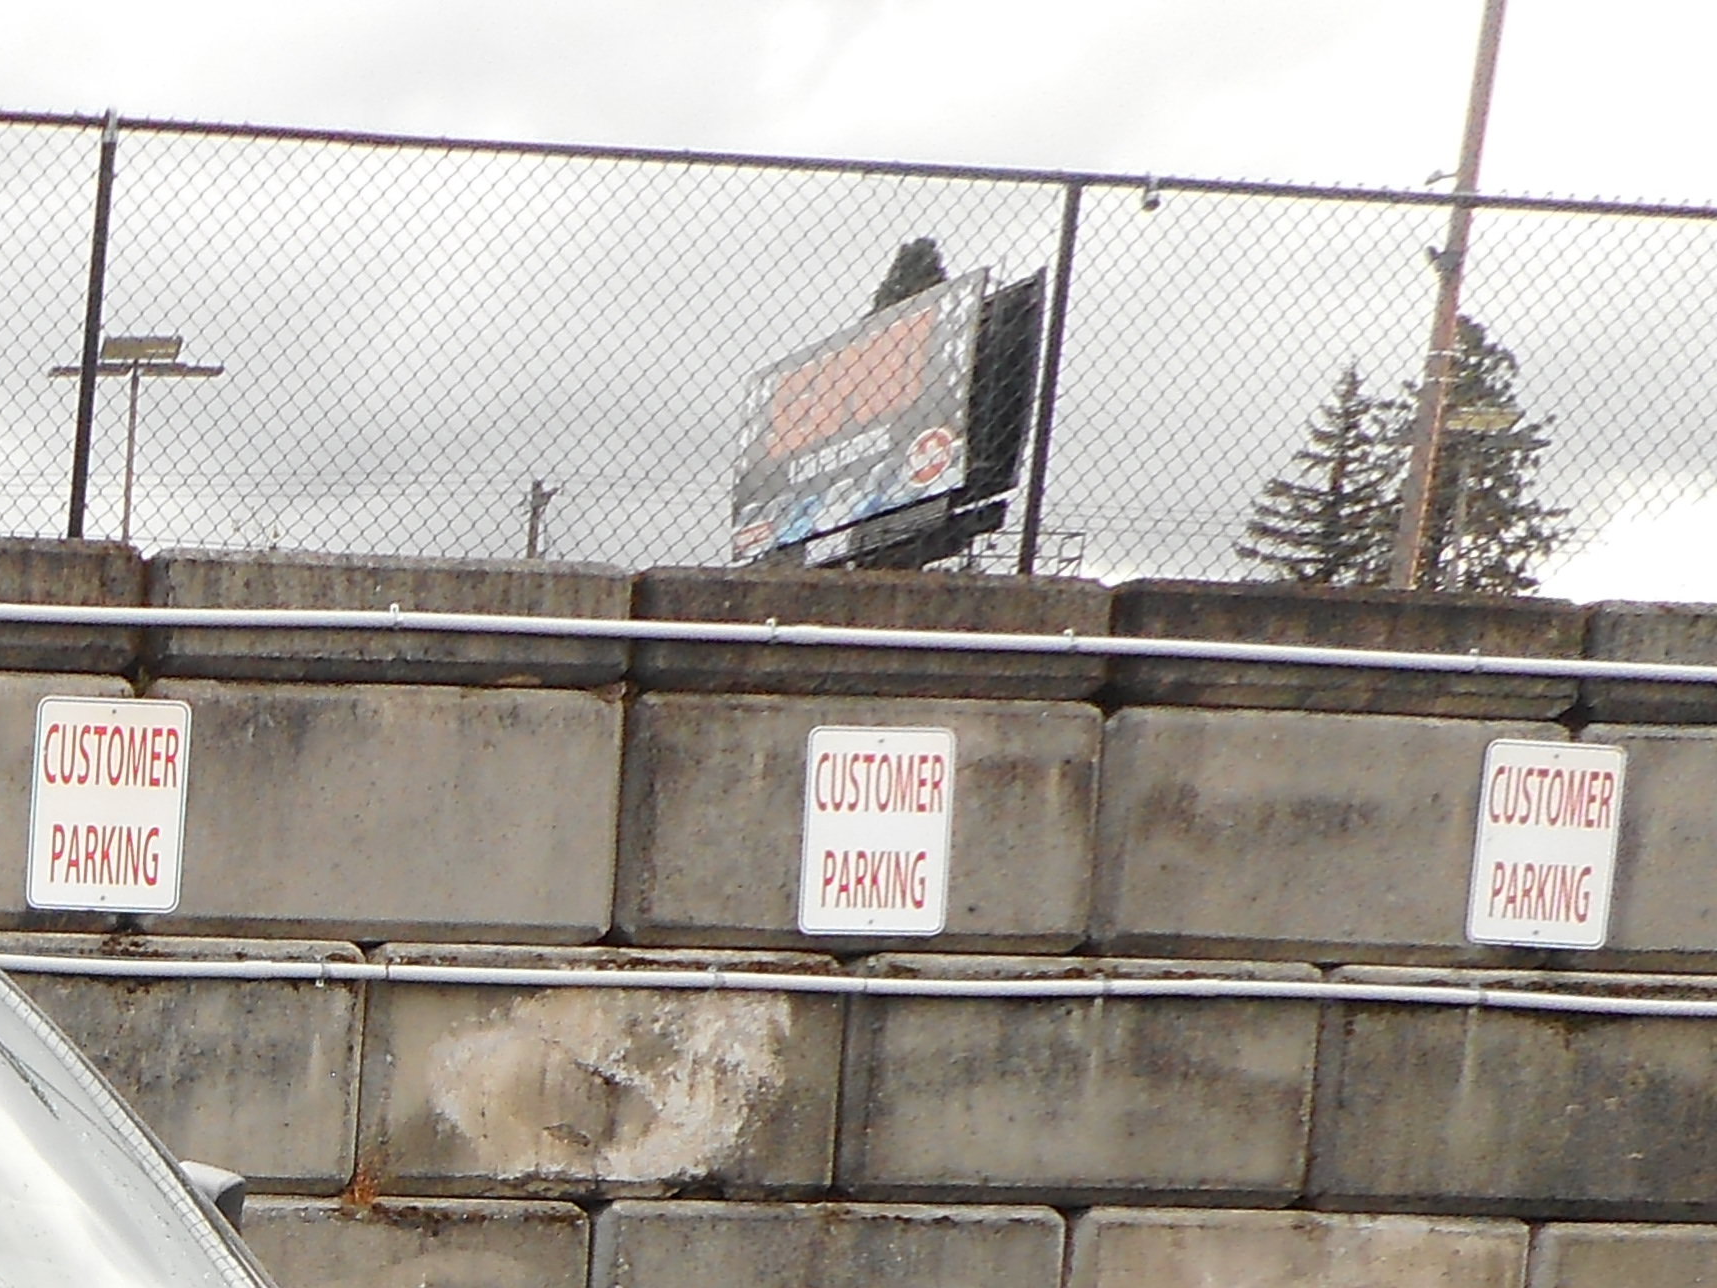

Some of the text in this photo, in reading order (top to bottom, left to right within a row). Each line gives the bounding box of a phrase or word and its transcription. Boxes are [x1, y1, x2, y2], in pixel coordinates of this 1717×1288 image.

[43, 723, 180, 788] CUSTOMER
[815, 752, 945, 813] CUSTOMER
[1488, 765, 1615, 829] CUSTOMER
[49, 823, 161, 886] PARKING
[820, 850, 927, 909] PARKING
[1488, 860, 1593, 924] PARKING
